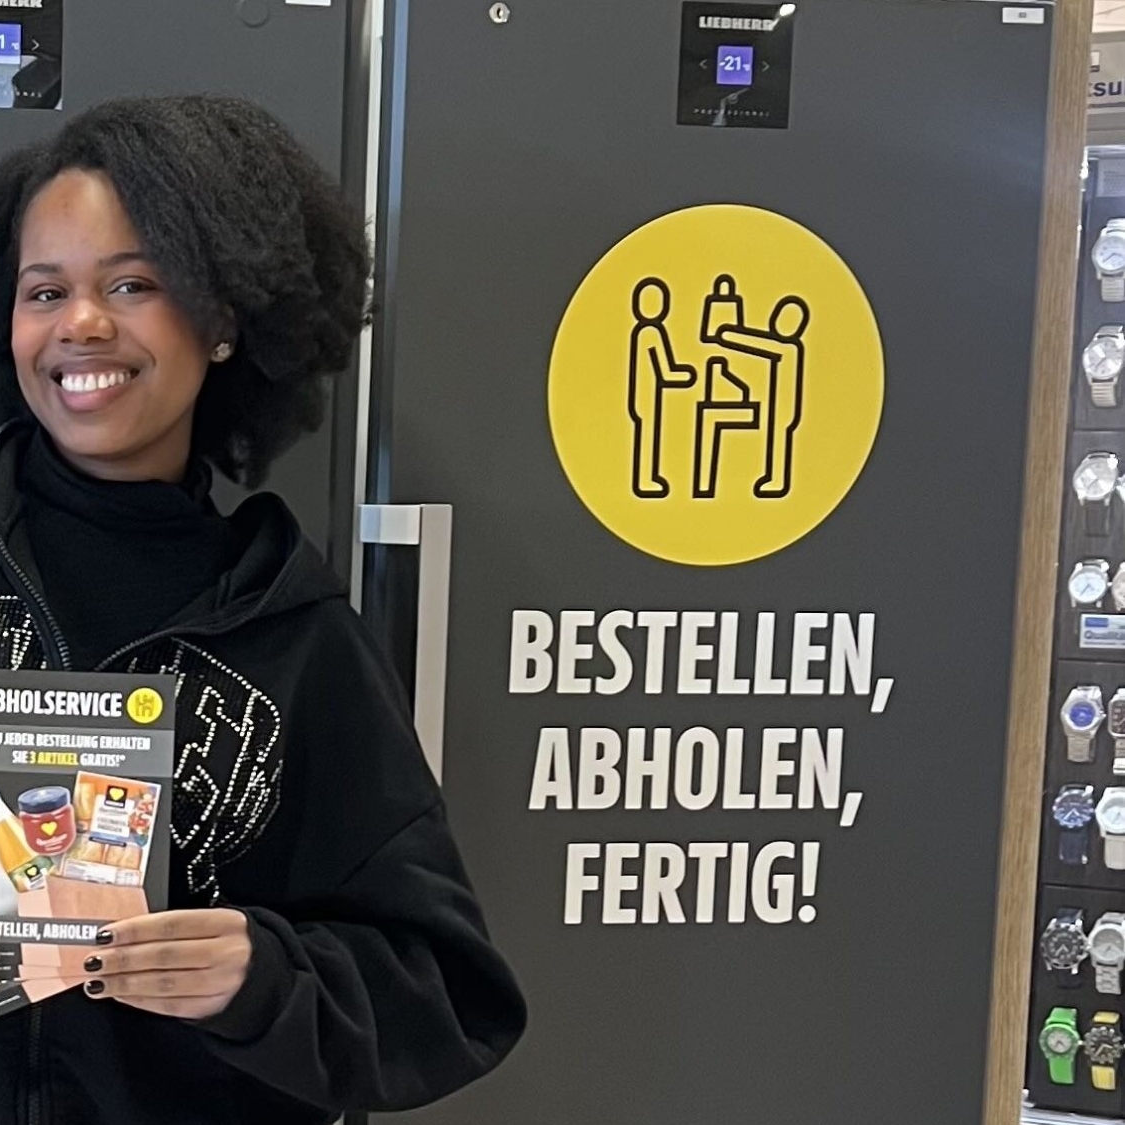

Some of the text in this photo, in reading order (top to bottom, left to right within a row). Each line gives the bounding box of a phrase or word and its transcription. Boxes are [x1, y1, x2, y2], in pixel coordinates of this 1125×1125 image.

[508, 609, 894, 713] BESTELLEN,
[3, 733, 35, 746] JEDER
[36, 734, 99, 749] BESTELLUNG
[99, 736, 151, 750] ERHALTEN
[12, 750, 29, 764] SIE
[37, 752, 79, 766] ARTIKEL
[528, 726, 863, 827] ABHOLEN,
[564, 841, 820, 924] FERTIG!
